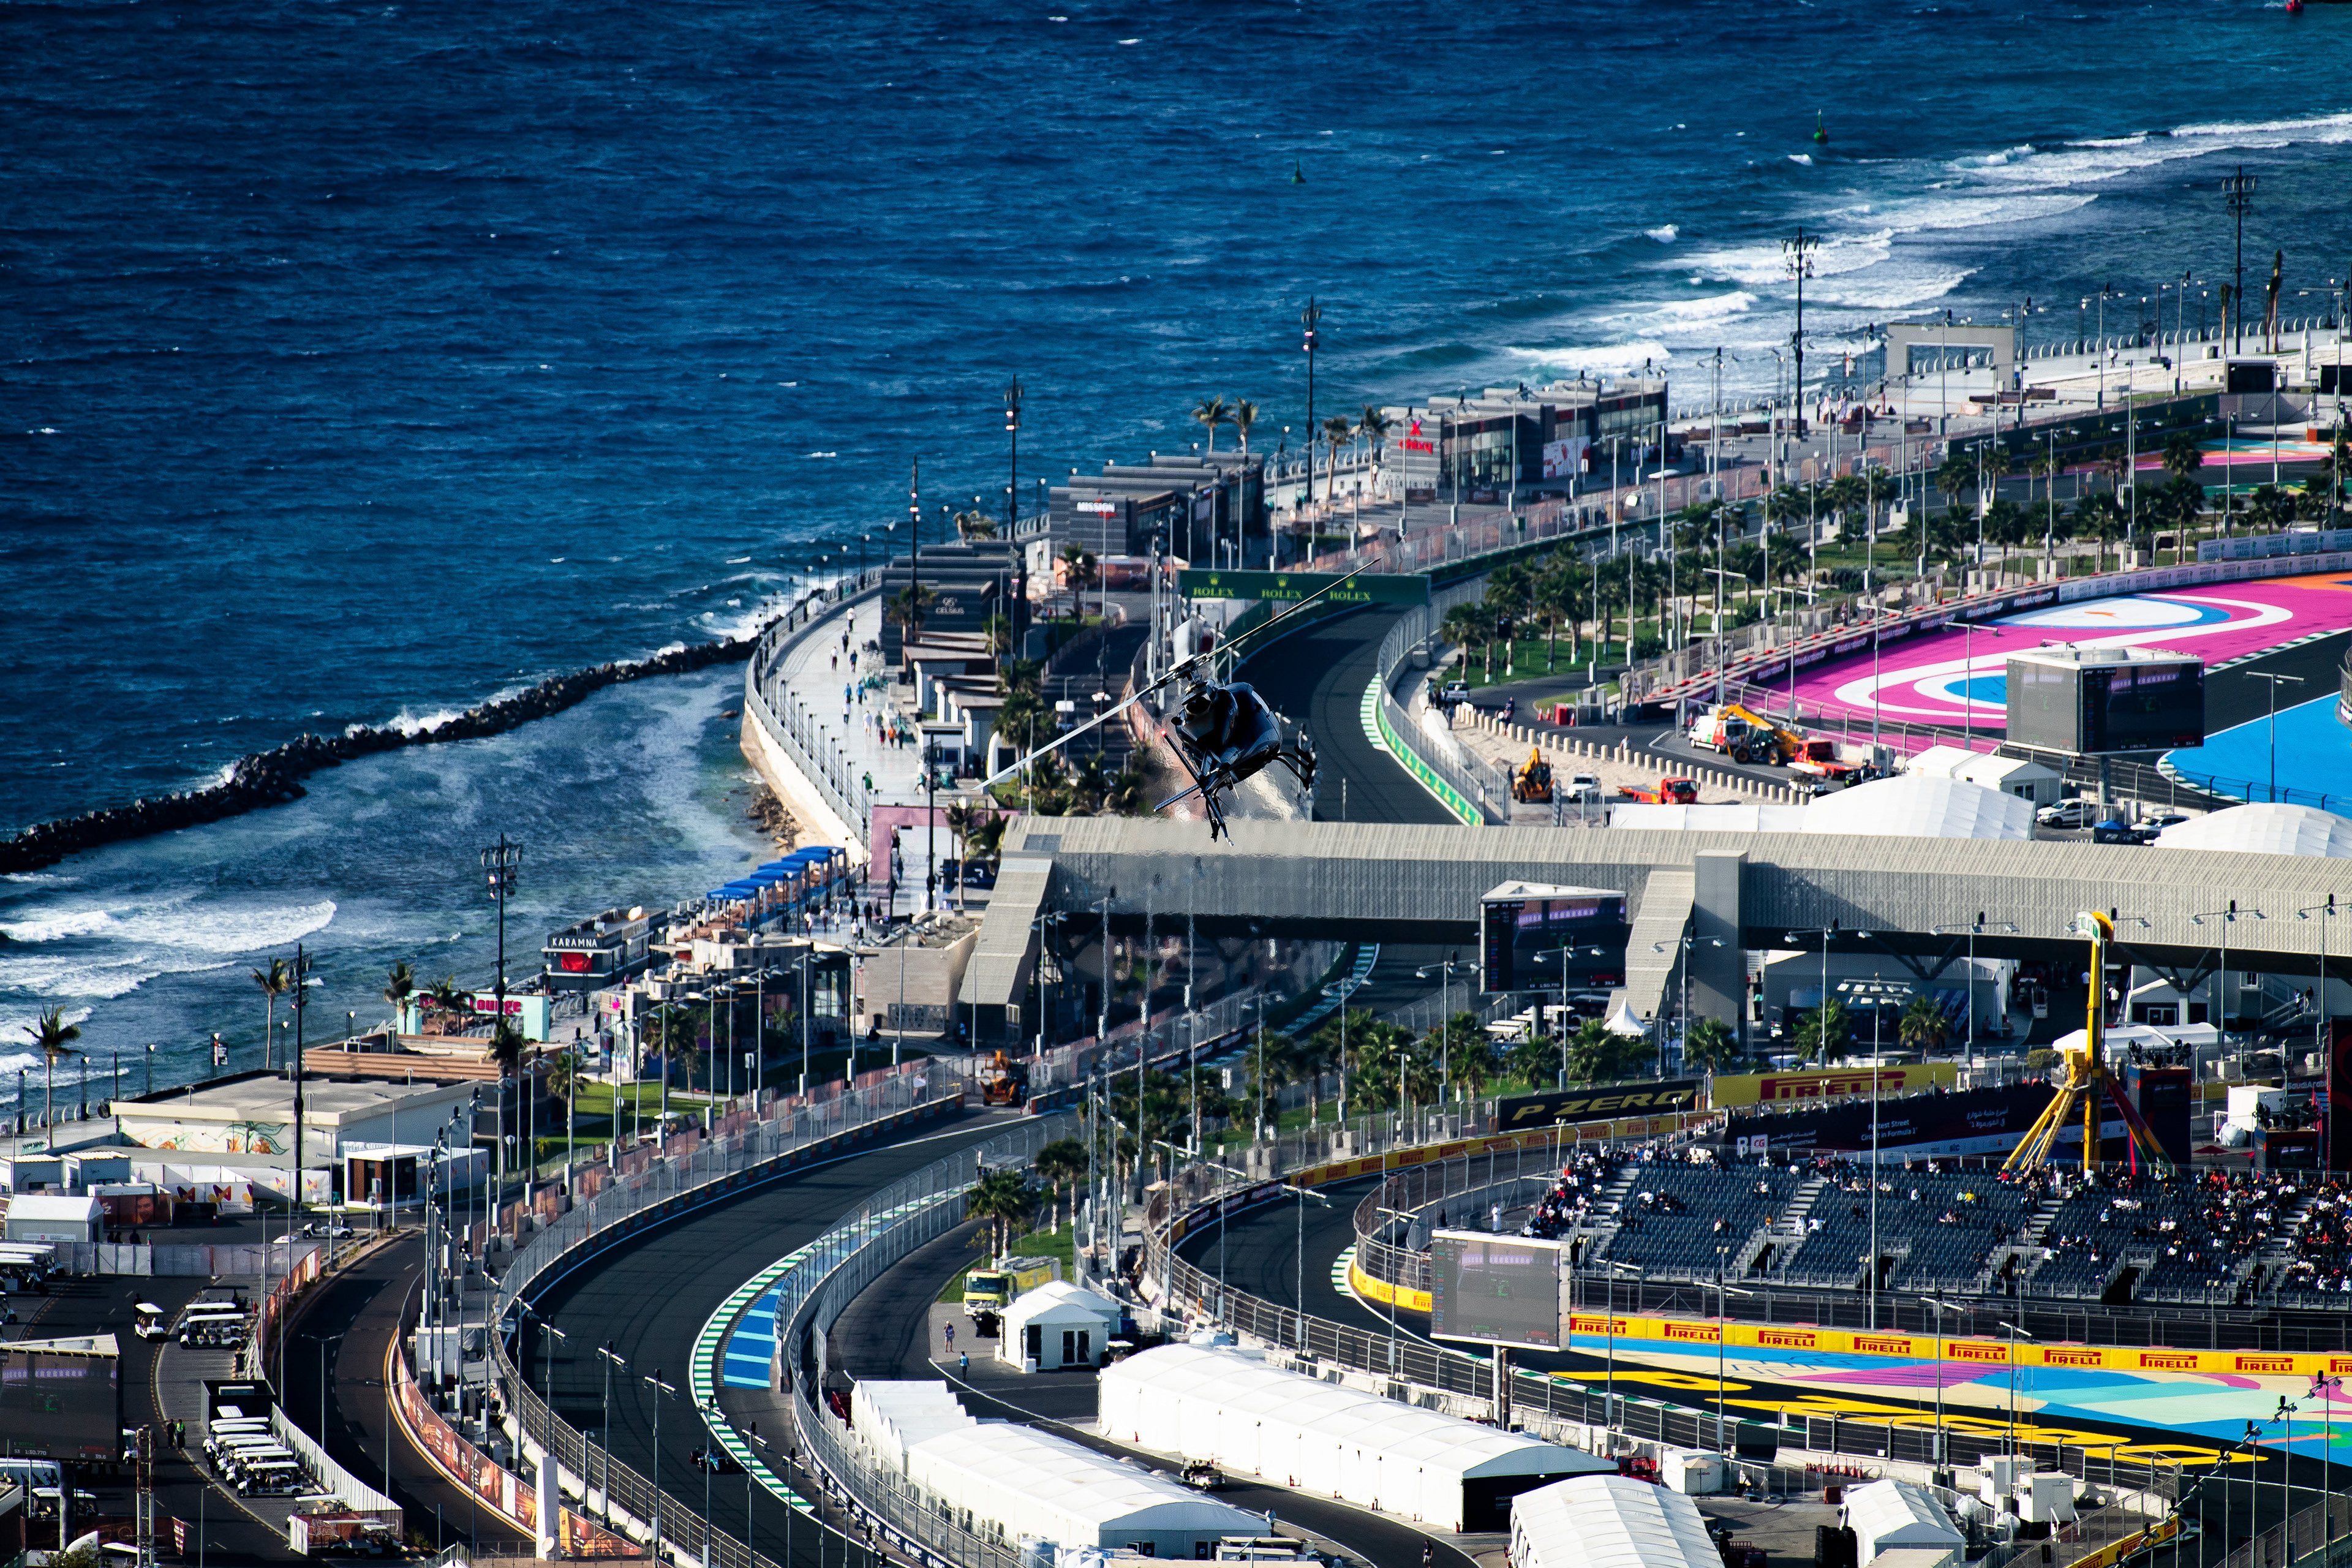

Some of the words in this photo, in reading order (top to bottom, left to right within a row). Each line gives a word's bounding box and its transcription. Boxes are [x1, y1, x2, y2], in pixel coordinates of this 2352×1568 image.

[1193, 587, 1234, 598] ROLEX
[1262, 589, 1302, 600] ROLEX
[1330, 590, 1371, 601] ROLEX
[552, 937, 598, 948] KARAMNA
[1512, 1104, 1545, 1121] P
[1554, 1089, 1694, 1116] ZERO
[1888, 1128, 1912, 1137] Formula
[1754, 1139, 1765, 1148] CG
[1570, 1317, 1626, 1335] PIRELLI
[1664, 1323, 1721, 1341] PIRELLI
[1758, 1330, 1815, 1347] PIRELLI
[1854, 1336, 1911, 1354] PIRELLI
[1949, 1343, 2006, 1360] PIRELLI
[2045, 1349, 2101, 1365] PIRELLI
[2140, 1353, 2197, 1369] PIRELLI
[2236, 1357, 2293, 1371] PIRELLI
[871, 1518, 880, 1531] MSC
[889, 1531, 900, 1546] MSC
[910, 1544, 922, 1559] MSC
